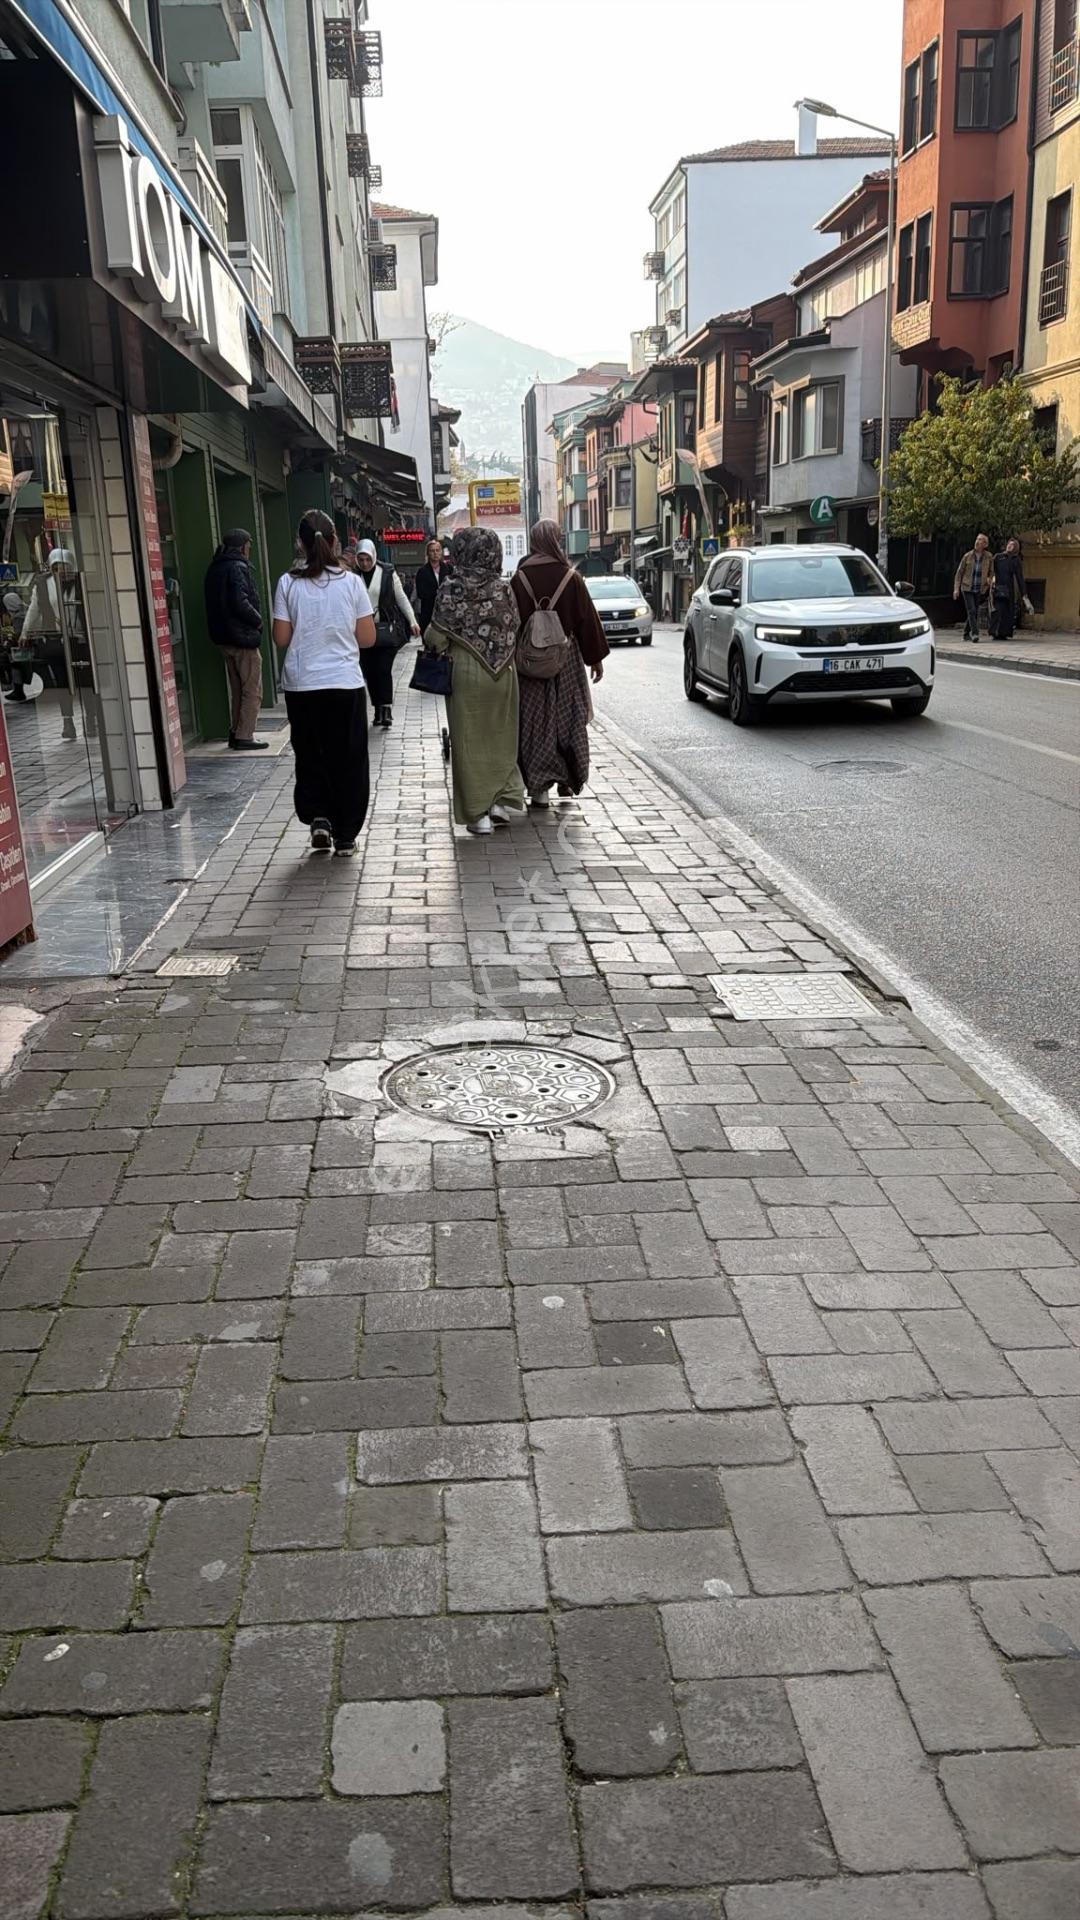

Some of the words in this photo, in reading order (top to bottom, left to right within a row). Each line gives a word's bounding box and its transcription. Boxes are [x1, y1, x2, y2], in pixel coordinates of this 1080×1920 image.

[816, 498, 833, 519] A
[830, 660, 839, 670] 16
[844, 660, 861, 670] CAK
[866, 658, 881, 669] 471
